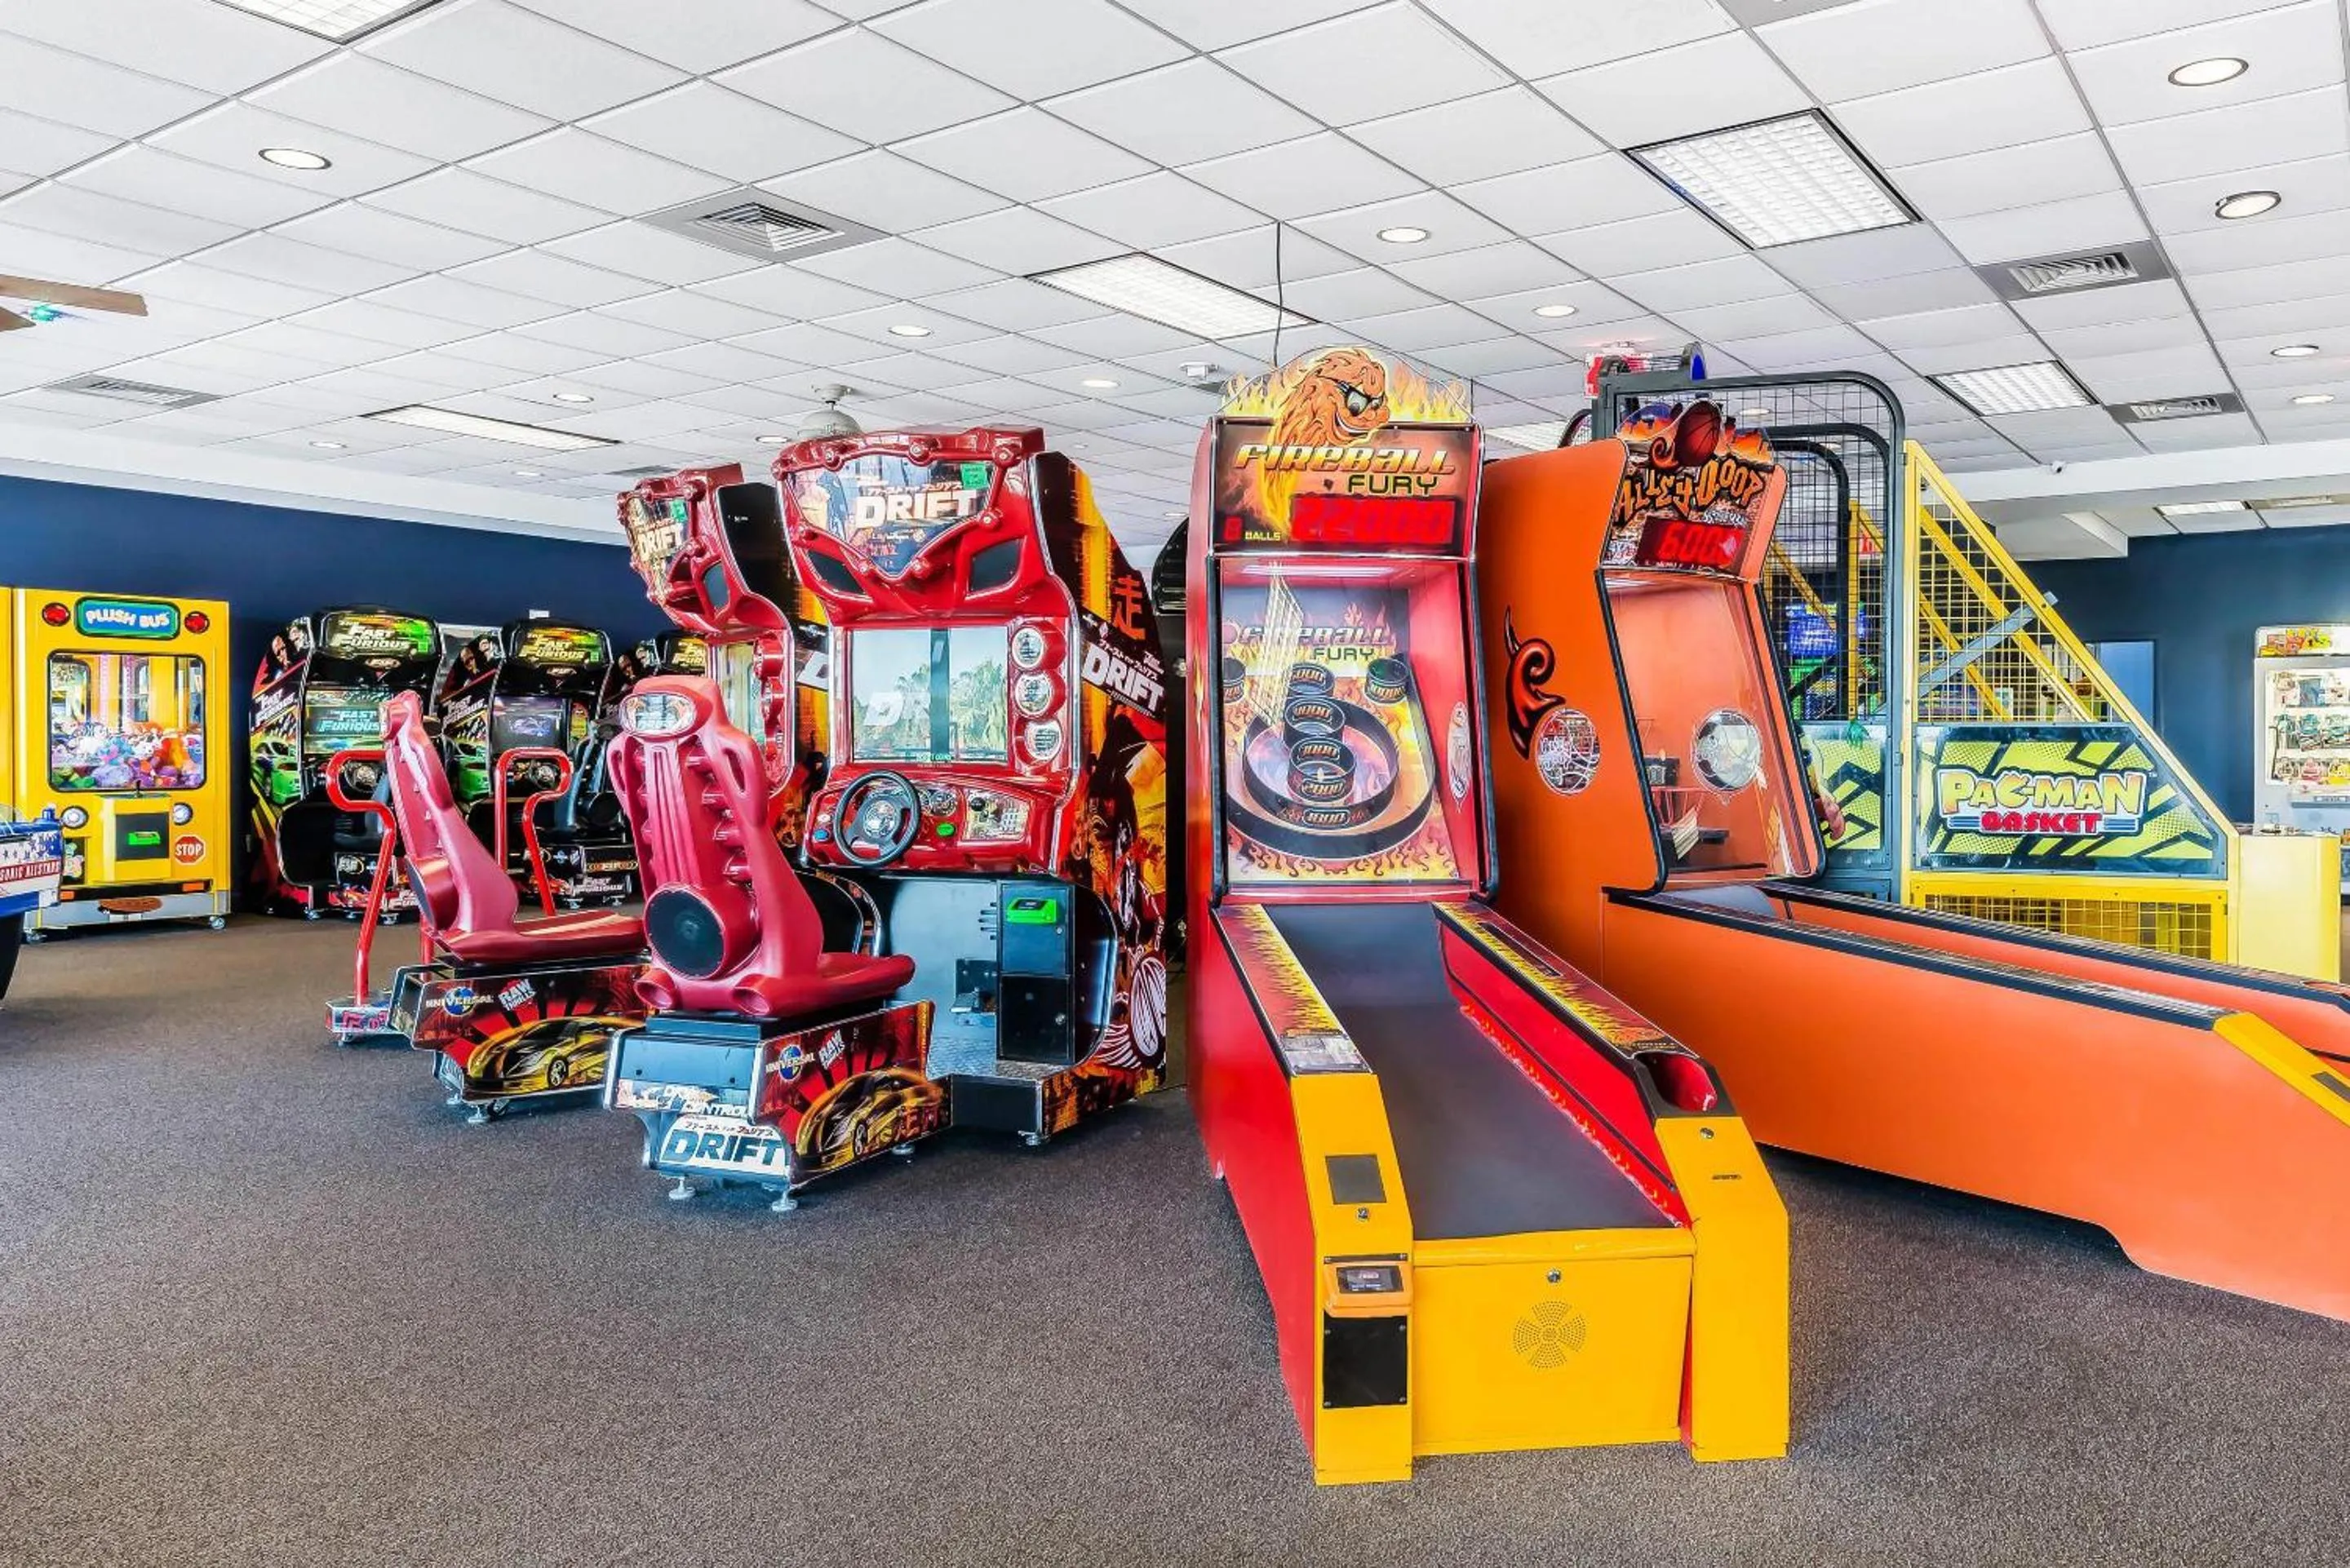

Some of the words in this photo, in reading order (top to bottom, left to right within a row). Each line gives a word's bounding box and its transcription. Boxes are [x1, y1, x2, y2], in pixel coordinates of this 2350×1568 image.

[1234, 445, 1456, 475] FIREBALL
[1348, 475, 1439, 495] FURY
[1615, 468, 1692, 522] ALLEY
[854, 489, 978, 529] DRIFT
[1245, 531, 1280, 541] BALLS
[85, 609, 136, 626] PLUSH
[140, 612, 170, 628] BUS
[348, 624, 396, 638] FAST
[330, 633, 410, 650] FURIOUS
[517, 645, 586, 658] FURIOUS
[1313, 648, 1376, 661] FURY
[1081, 644, 1164, 713] DRIFT
[339, 711, 378, 721] FAST
[319, 720, 386, 733] FURIOUS
[1941, 771, 2144, 814] PAC-MAN
[1980, 811, 2103, 832] BASKET
[175, 843, 203, 857] STOP
[0, 866, 23, 882] SONIC
[425, 994, 494, 1008] UNIVERSAL
[498, 978, 533, 1005] RAW
[765, 1052, 816, 1074] UNIVERSAL
[661, 1129, 783, 1166] DRIFT
